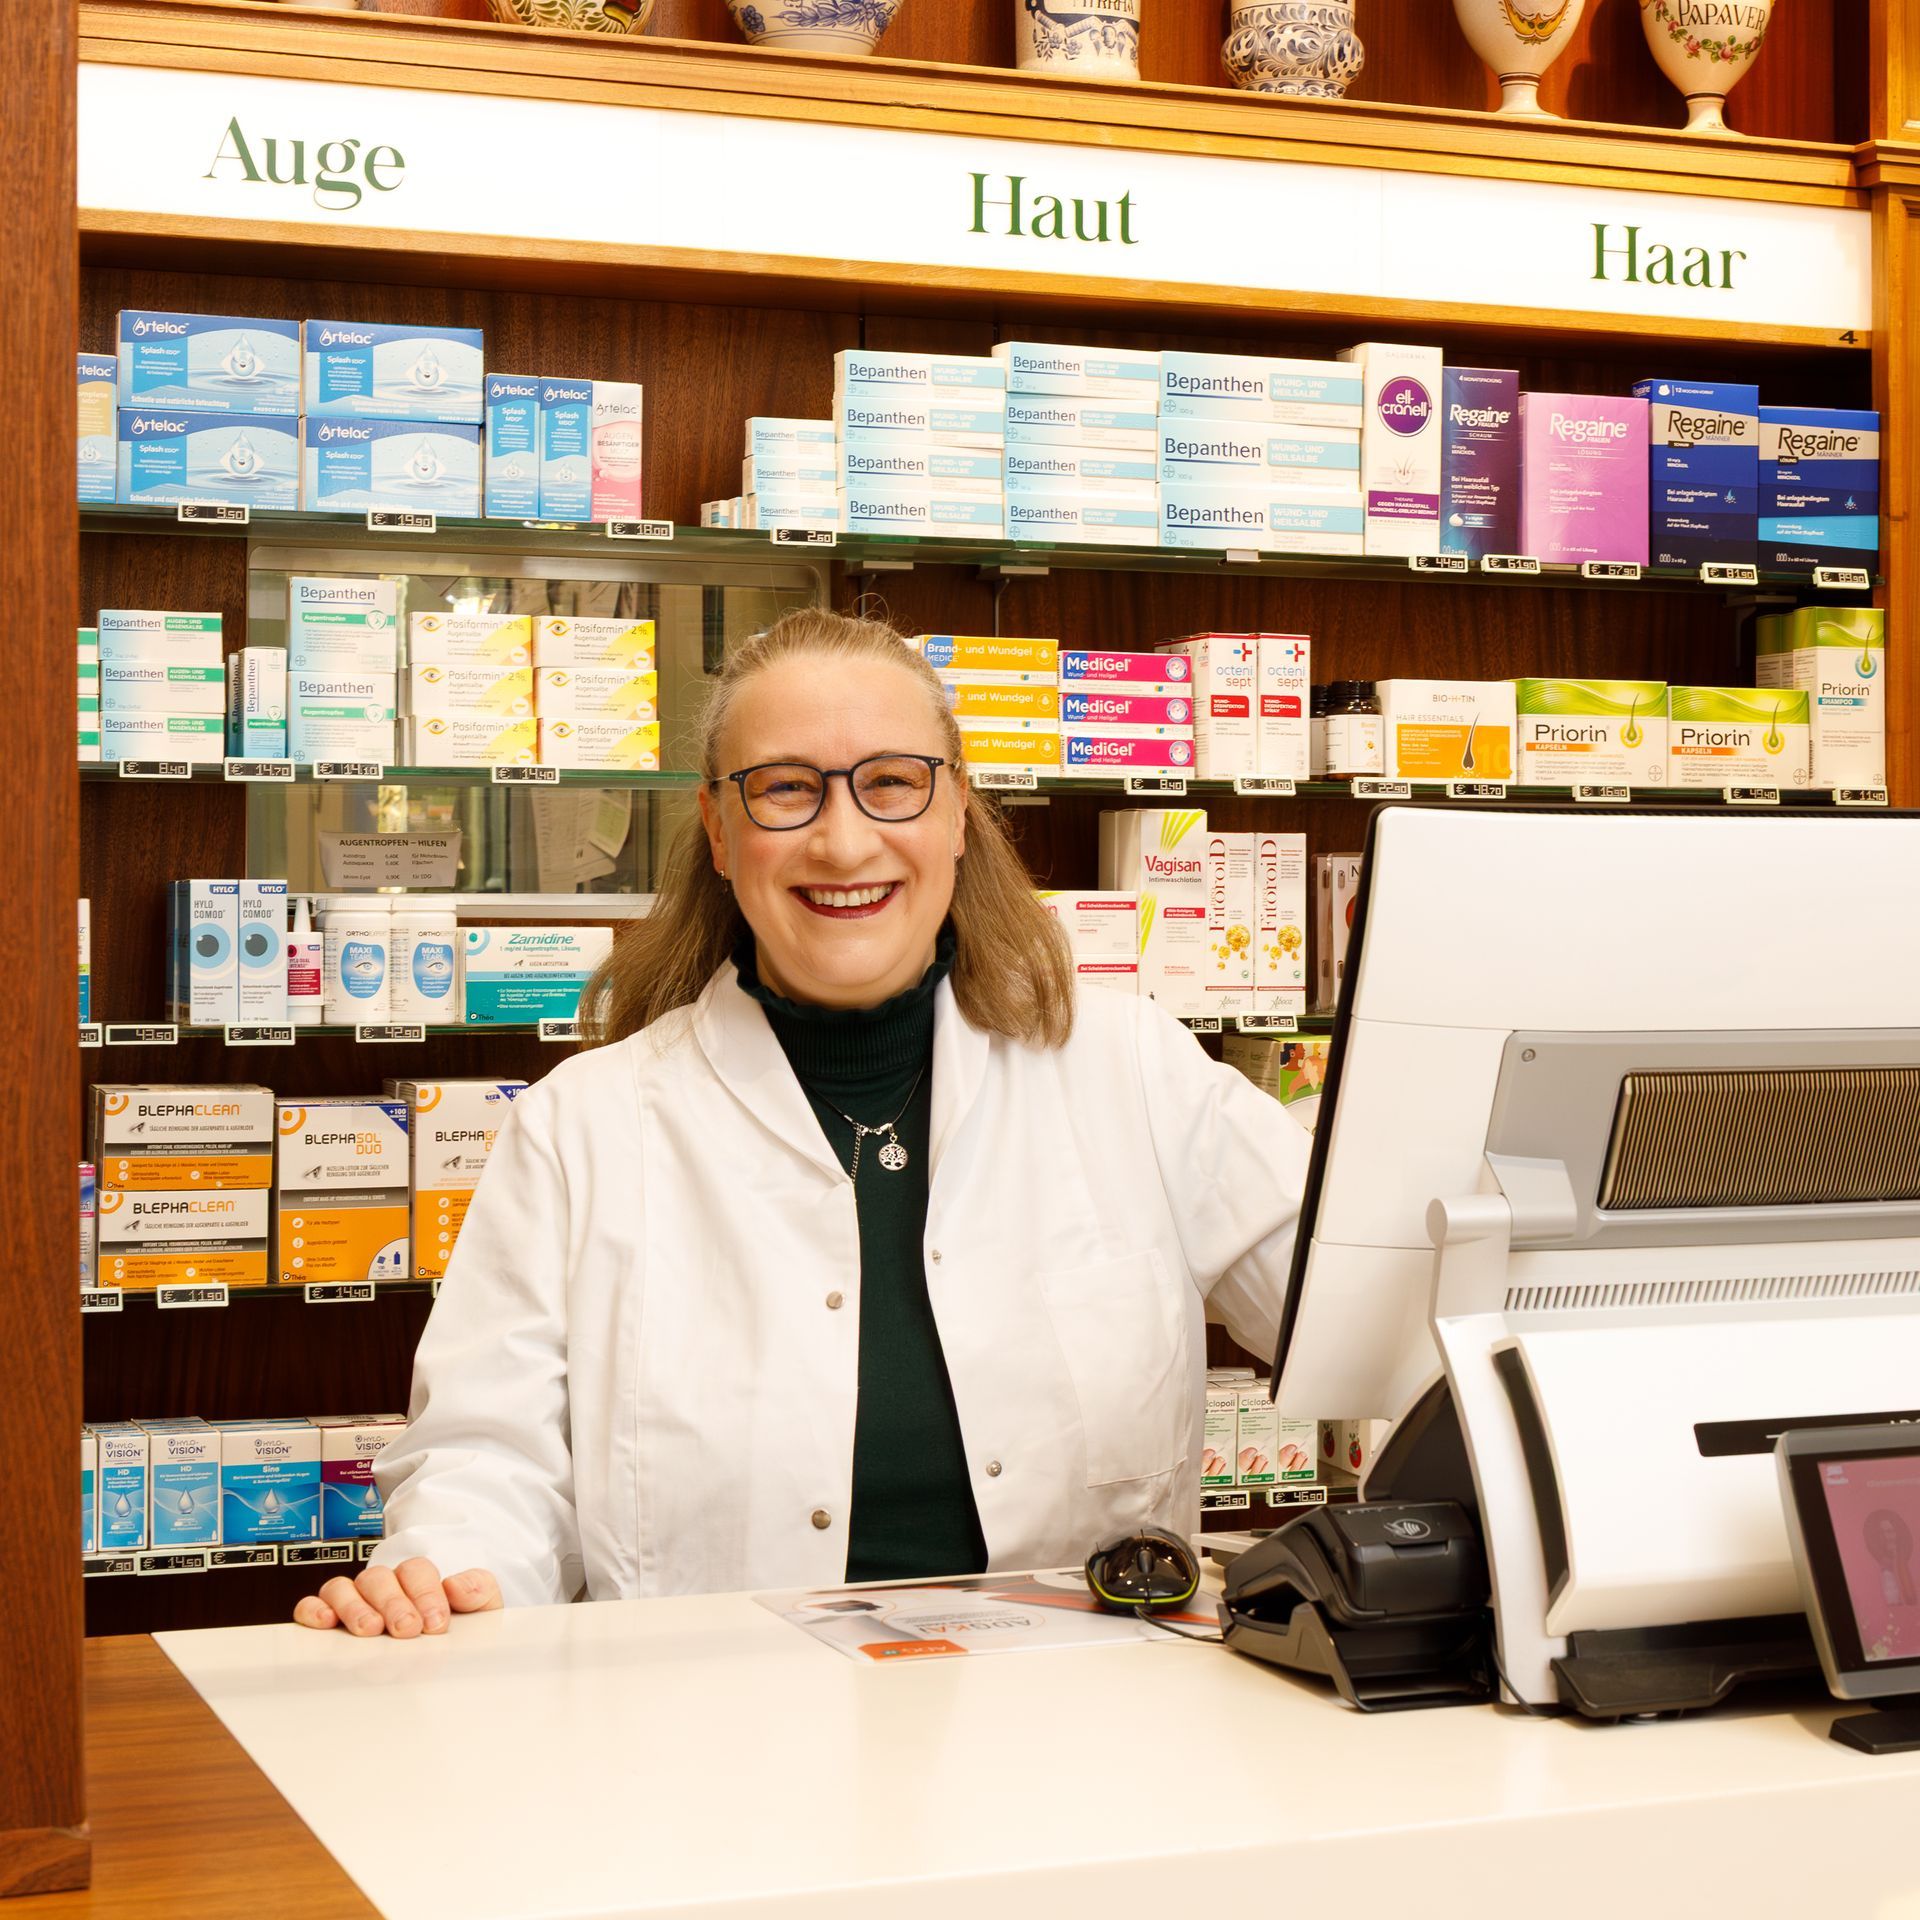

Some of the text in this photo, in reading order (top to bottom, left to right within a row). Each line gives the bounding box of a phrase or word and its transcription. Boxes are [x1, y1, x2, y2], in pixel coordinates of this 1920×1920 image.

[1678, 0, 1766, 31] PAPAVER
[203, 117, 405, 210] Auge
[969, 173, 1139, 245] Haut
[1591, 224, 1747, 289] Haar
[132, 316, 187, 337] Artelac
[319, 327, 372, 347] Artelac
[1839, 330, 1858, 345] 4
[141, 345, 165, 356] Splash
[327, 355, 351, 364] Splash
[1013, 356, 1080, 373] Bepanthen
[849, 363, 927, 381] Bepanthen
[490, 380, 535, 398] Artelac
[1166, 372, 1264, 394] Bepanthen
[543, 385, 588, 402] Artelac
[1395, 389, 1414, 404] ell-
[595, 402, 637, 418] Artelac
[1008, 407, 1076, 423] Bepanthen
[1381, 401, 1428, 417] cranell
[1449, 404, 1510, 428] Regaine
[847, 408, 925, 425] Bepanthen
[131, 415, 186, 435] Artelac
[1549, 412, 1628, 443] Regaine
[1668, 409, 1746, 441] Regaine
[318, 423, 370, 442] Artelac
[1164, 437, 1261, 459] Bepanthen
[1778, 427, 1859, 458] Regaine
[848, 454, 924, 472] Bepanthen
[1008, 456, 1076, 473] Bepanthen
[184, 506, 244, 520] € 9.50
[760, 506, 799, 517] Bepanthen
[850, 500, 926, 518] Bepanthen
[1010, 505, 1078, 521] Bepanthen
[1166, 503, 1264, 525] Bepanthen
[374, 512, 432, 528] € 19.90
[614, 523, 670, 537] € 18.00
[778, 530, 831, 544] € 2.60
[1418, 556, 1464, 569] € 44.90
[1490, 557, 1536, 570] € 61.90
[300, 586, 376, 605] Bepanthen
[102, 618, 161, 633] Bepanthen
[574, 624, 624, 635] Posiformin
[927, 643, 1034, 658] Brand- und Wundgel
[928, 655, 959, 663] MEDICE
[1066, 656, 1128, 673] MediGel
[105, 668, 164, 683] Bepanthen
[1216, 665, 1253, 677] octeni
[1267, 665, 1306, 677] octeni
[247, 657, 256, 713] Bepanthen
[575, 675, 625, 686] Posiformin
[1225, 676, 1252, 691] sept
[1277, 676, 1304, 691] sept
[299, 680, 374, 698] Bepanthen
[1821, 682, 1870, 697] Priorin
[1432, 694, 1476, 704] BIO-H-TIN
[1821, 697, 1854, 706] SHAMPOO
[1066, 699, 1129, 716] MediGel
[1396, 713, 1464, 723] HAIR ESSENTIALS
[105, 719, 164, 733] Bepanthen
[577, 726, 628, 737] Posiformin
[1535, 723, 1607, 743] Priorin
[1681, 728, 1750, 747] Priorin
[1071, 742, 1133, 759] MediGel
[1536, 744, 1568, 752] KAPSELN
[1681, 747, 1712, 755] KAPSELN
[126, 763, 186, 775] € 8.40
[231, 764, 289, 776] € 14.70
[1455, 783, 1502, 795] € 48.70
[339, 839, 447, 848] AUGENTROPFEN HILFEN
[1144, 855, 1202, 877] Vagisan
[1148, 876, 1203, 885] Intimwaschlotion
[213, 885, 236, 895] HYLO
[261, 885, 285, 895] HYLO
[194, 900, 213, 911] HYLO
[243, 900, 263, 911] HYLO
[194, 909, 224, 920] COMOD
[243, 909, 272, 920] COMOD
[508, 933, 575, 946] Zamidine
[349, 946, 373, 956] MAXI
[421, 946, 444, 956] MAXI
[1189, 1017, 1218, 1030] 13.40
[1244, 1016, 1293, 1029] € 16.90
[136, 1029, 172, 1041] 43.50
[231, 1028, 289, 1040] € 14.00
[362, 1026, 420, 1039] € 42.90
[139, 1103, 240, 1117] BLEPHACLEAN
[389, 1108, 406, 1116] +100
[305, 1132, 382, 1146] BLEPHASOL
[356, 1143, 382, 1155] DUO
[133, 1200, 235, 1215] BLEPHACLEAN
[312, 1285, 369, 1299] € 14.40
[106, 1448, 142, 1459] VISION
[169, 1446, 204, 1456] VISION
[255, 1446, 289, 1456] VISION
[118, 1469, 130, 1477] HD
[180, 1465, 193, 1473] HD
[1274, 1490, 1323, 1504] € 46.90
[290, 1548, 348, 1561] € 10.90
[105, 1560, 133, 1572] 7.90
[143, 1555, 202, 1570] € 14.50
